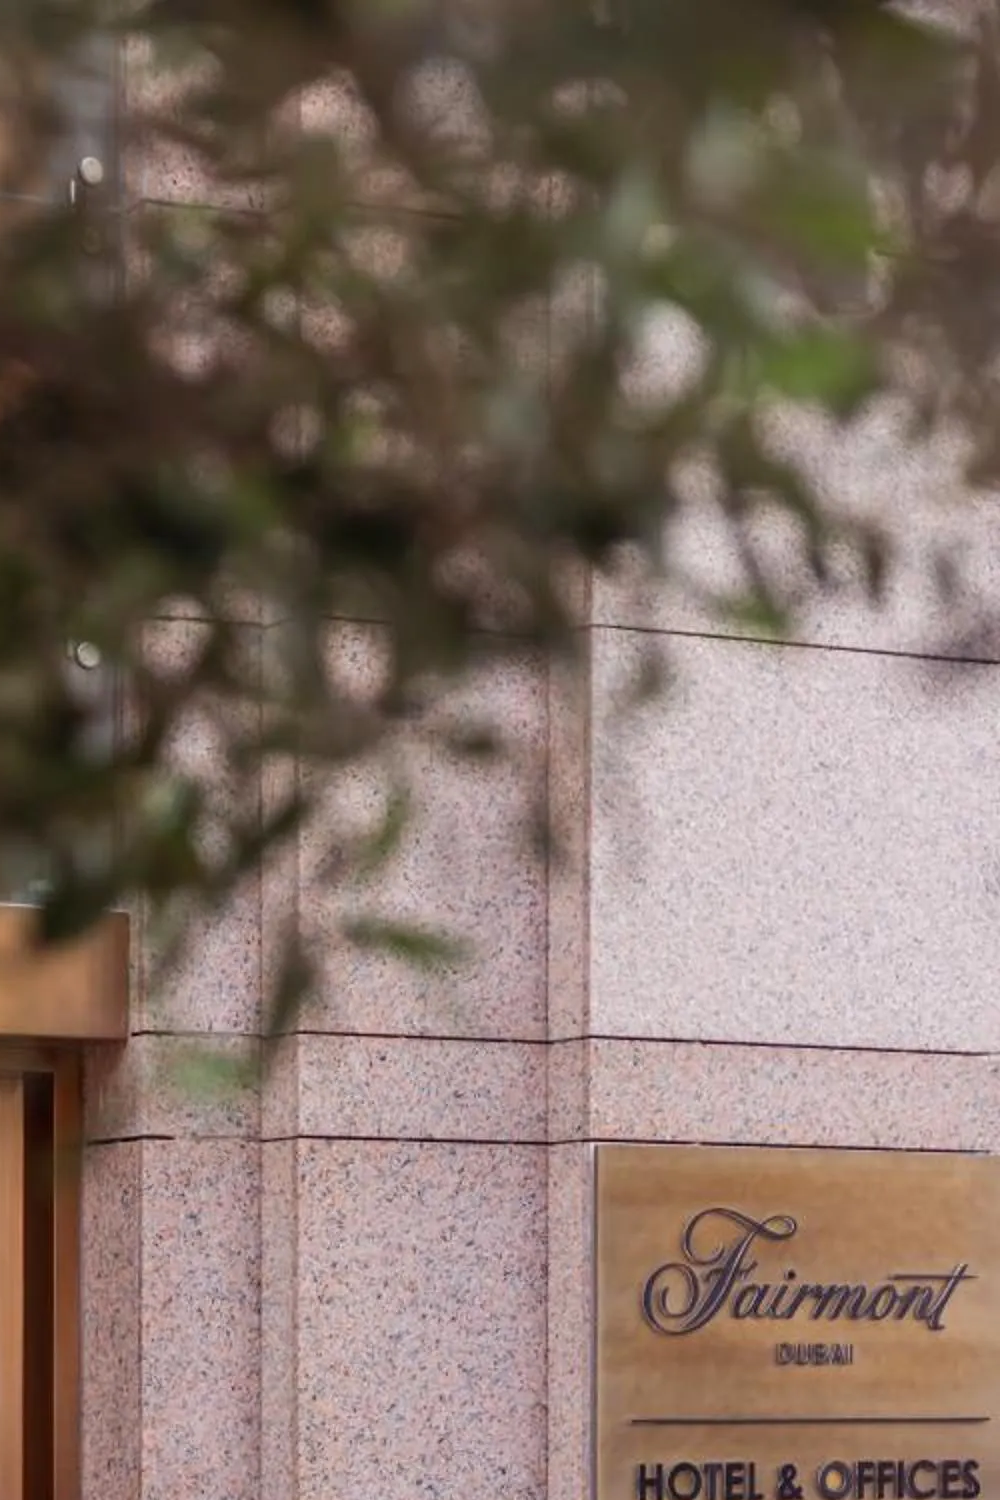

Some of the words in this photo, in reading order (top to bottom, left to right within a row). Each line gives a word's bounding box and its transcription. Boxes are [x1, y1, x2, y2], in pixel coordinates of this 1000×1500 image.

[643, 1207, 979, 1336] Fairmont
[775, 1342, 854, 1366] DUBAI
[817, 1460, 982, 1500] OFFICES
